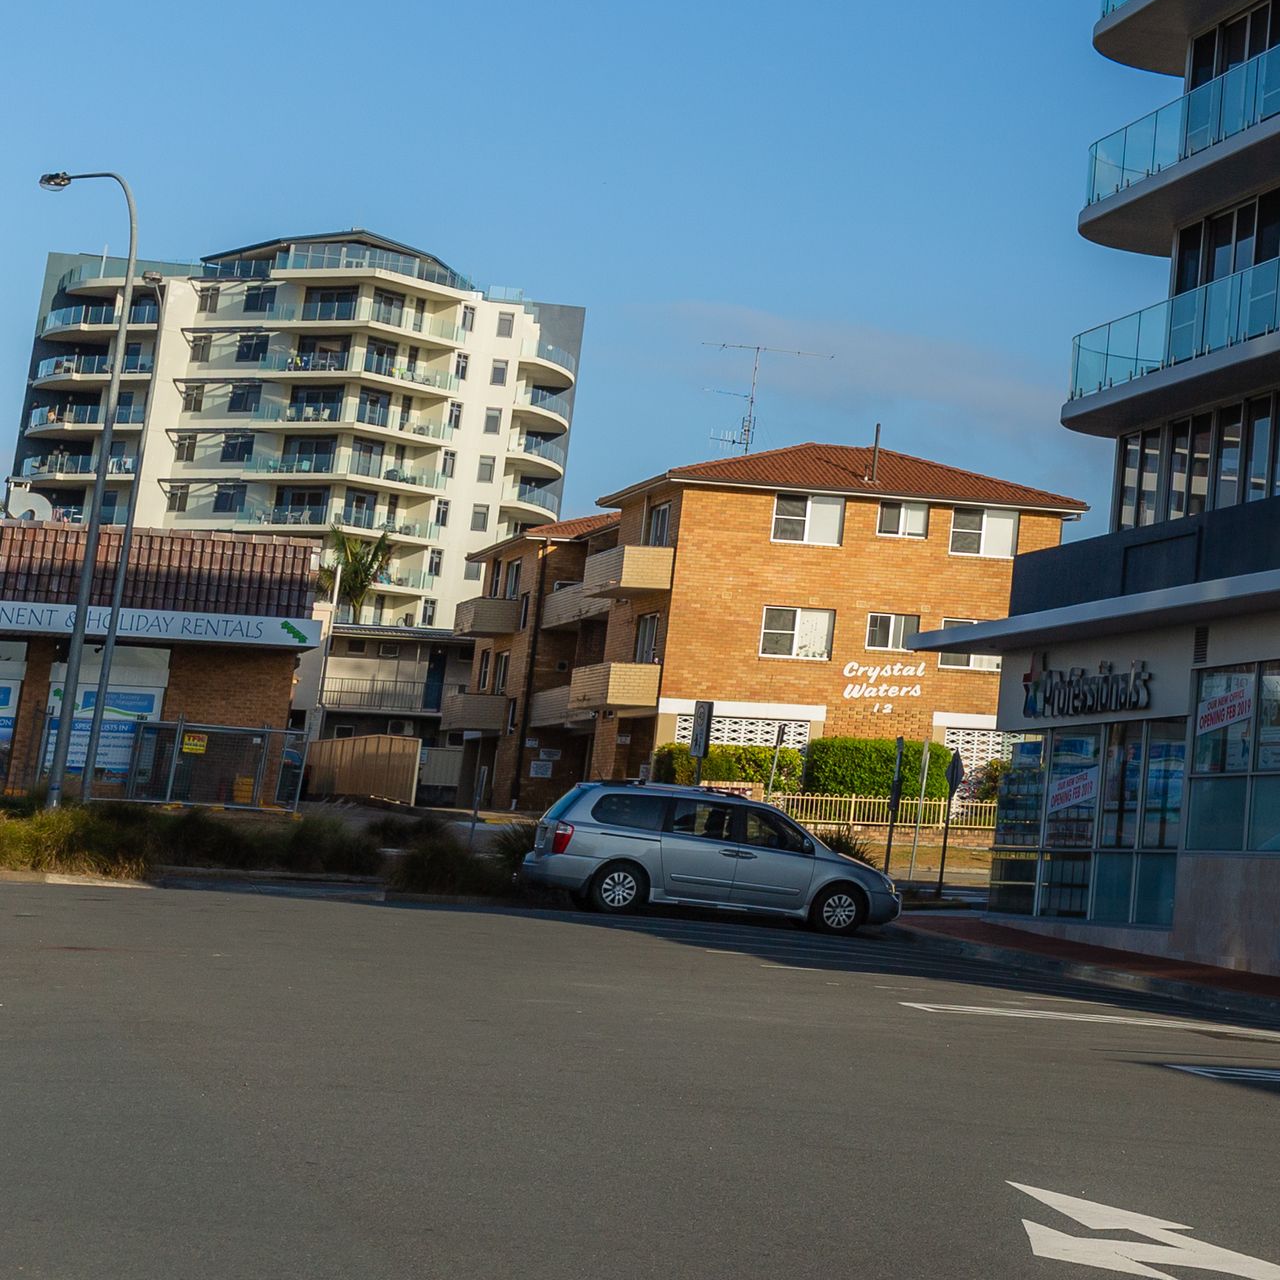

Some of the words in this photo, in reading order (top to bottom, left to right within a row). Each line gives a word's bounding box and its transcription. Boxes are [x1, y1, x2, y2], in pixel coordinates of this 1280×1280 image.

[181, 617, 264, 639] RENTALS
[843, 661, 926, 684] Crystal
[843, 682, 922, 700] Waters
[1200, 708, 1226, 730] OPENING
[1226, 704, 1237, 721] FEB
[1237, 698, 1252, 717] 2019
[119, 724, 129, 732] IN
[1050, 787, 1072, 809] OPENING
[1072, 785, 1081, 800] FEB
